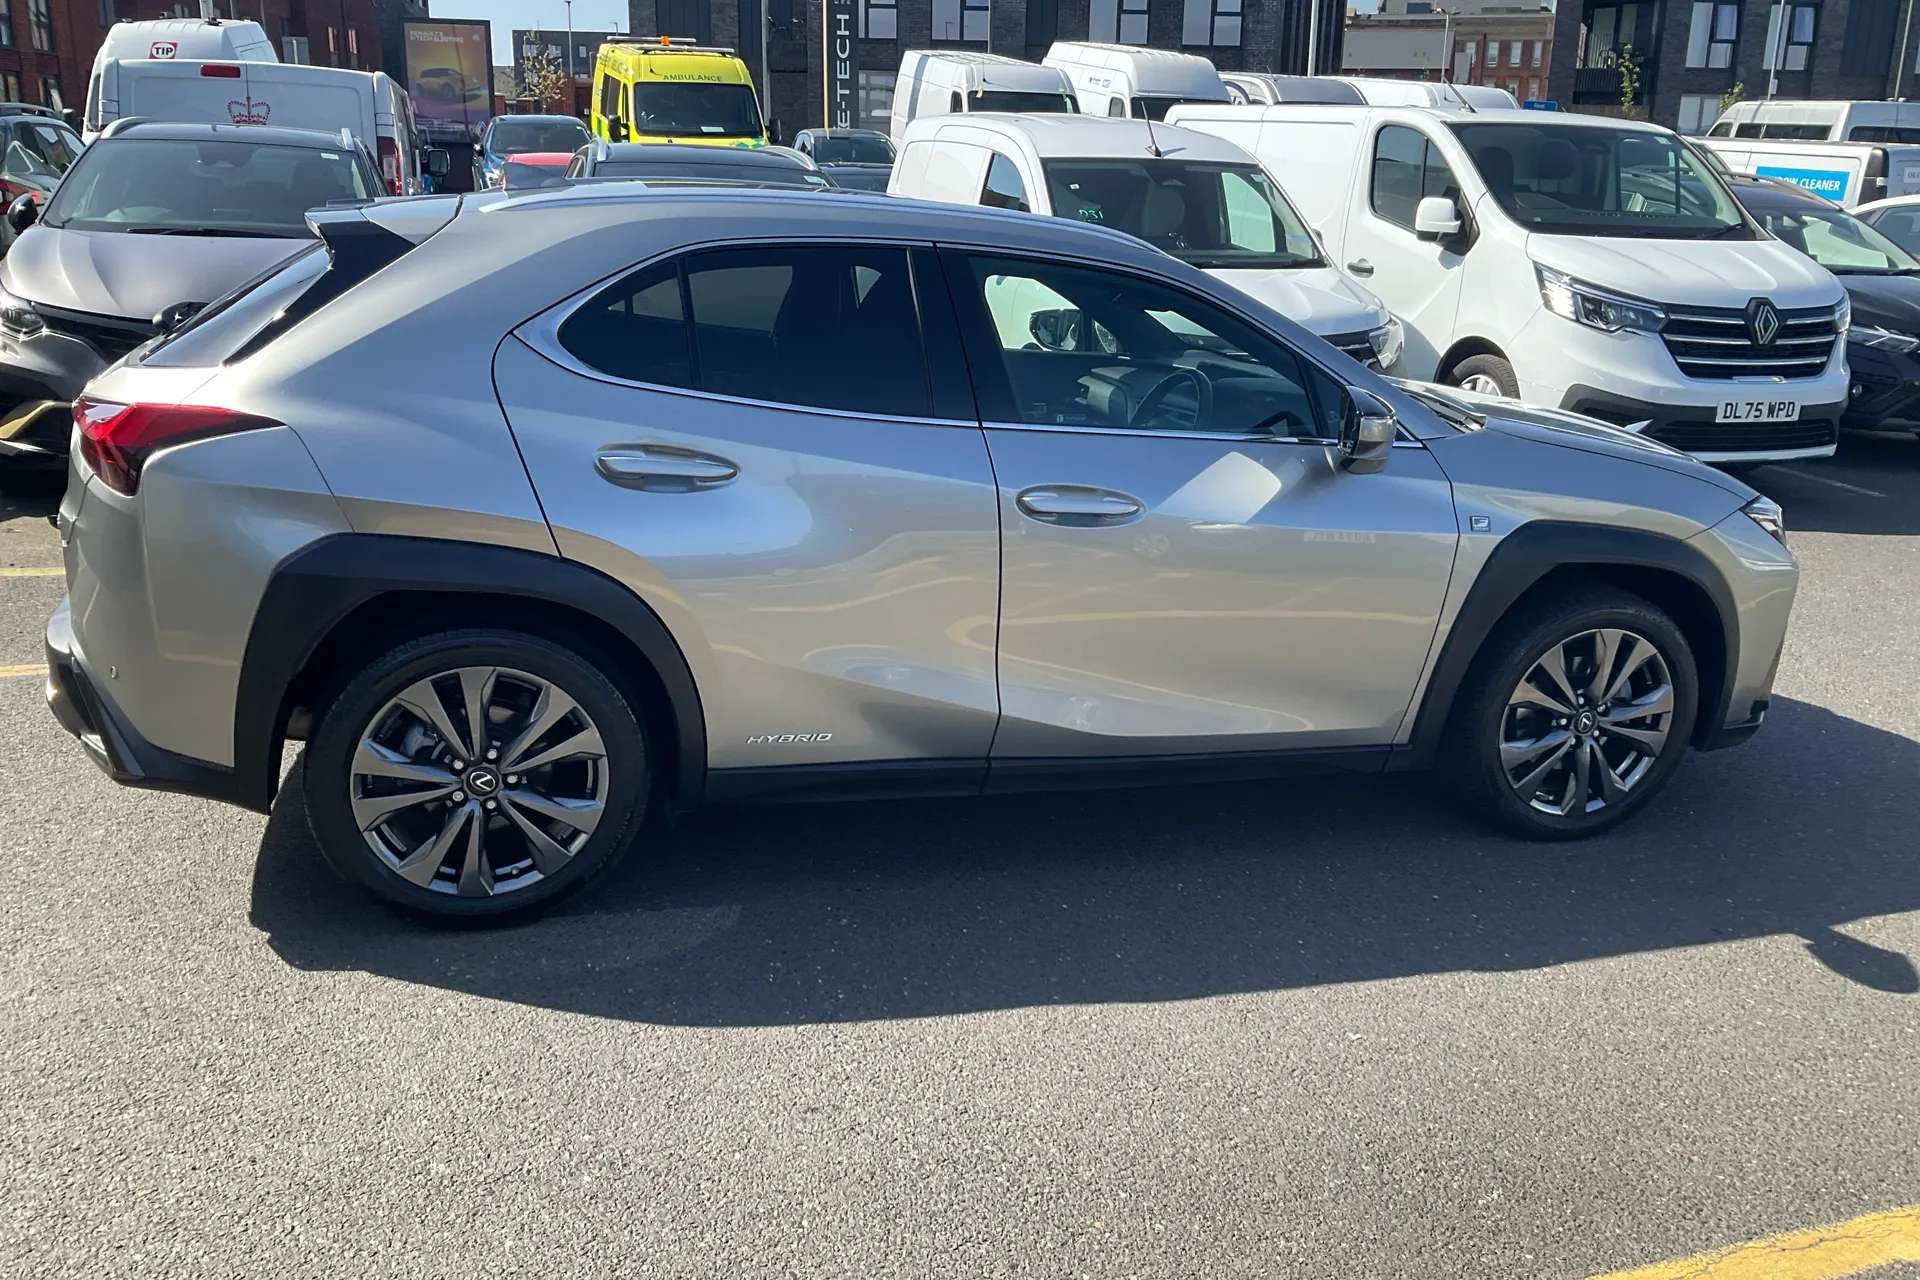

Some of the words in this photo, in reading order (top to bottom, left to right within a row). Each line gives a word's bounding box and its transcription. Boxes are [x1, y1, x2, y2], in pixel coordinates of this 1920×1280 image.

[154, 46, 174, 56] TIP
[663, 74, 723, 82] AMBULANCE
[1799, 178, 1841, 192] CLEANER
[1722, 402, 1764, 419] DL75
[1767, 401, 1796, 418] WPD
[747, 733, 832, 744] HYBRID
